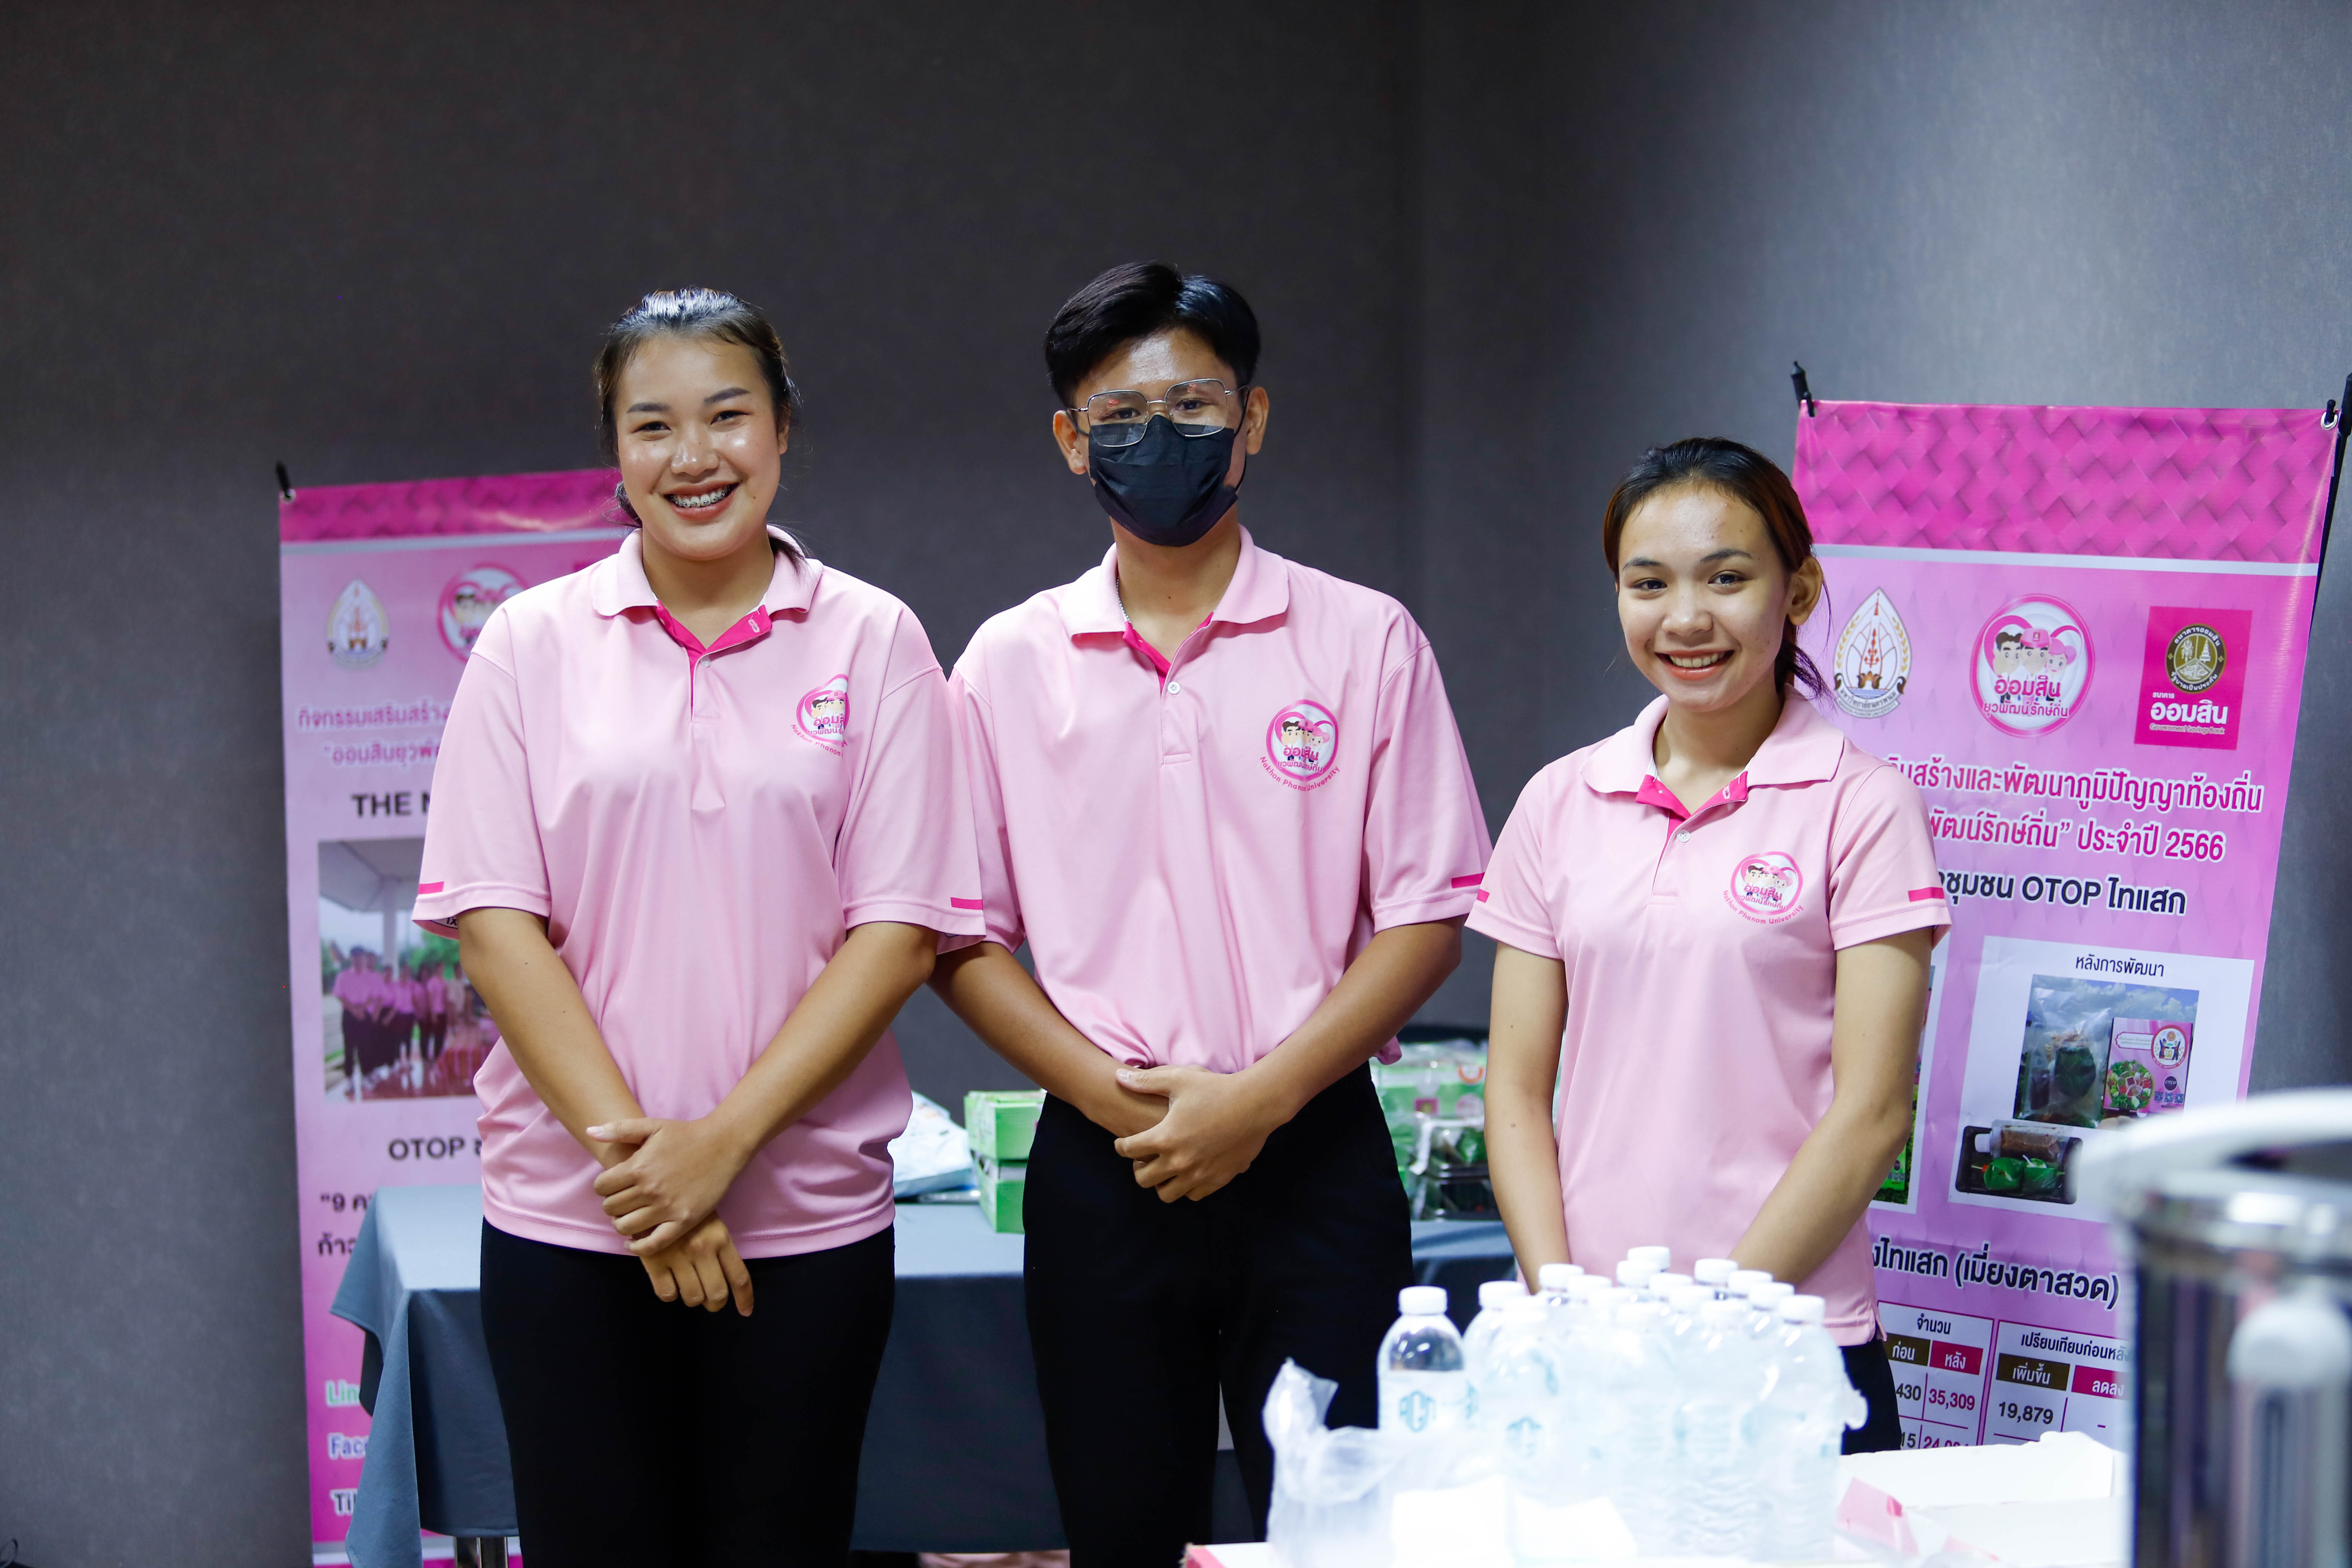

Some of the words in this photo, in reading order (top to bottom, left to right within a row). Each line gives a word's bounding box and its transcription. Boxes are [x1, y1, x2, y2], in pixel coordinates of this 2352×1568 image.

[2150, 699, 2228, 724] ออมสิน
[1260, 756, 1281, 782] Nakhon
[1306, 766, 1340, 791] University
[351, 792, 412, 817] THE
[2078, 821, 2159, 855] ประจำปี
[2165, 831, 2223, 861] 2566
[1723, 890, 1737, 912] Nakhon
[1738, 910, 1766, 924] Phanom
[1769, 904, 1804, 924] University
[2022, 876, 2101, 905] OTOP
[2108, 877, 2186, 914] ไทแสก
[2075, 953, 2164, 977] หลังการพัฒนา
[389, 1136, 465, 1161] OTOP
[1955, 1244, 2120, 1310] (เมี่ยงตาสวด)
[1917, 1313, 1951, 1335] จำนวน
[1892, 1341, 1916, 1361] ก่อน
[1944, 1351, 1966, 1369] หลัง
[2012, 1362, 2051, 1385] เพิ่มขึ้น
[1928, 1388, 1975, 1411] 35,309
[1998, 1401, 2054, 1425] 19,879
